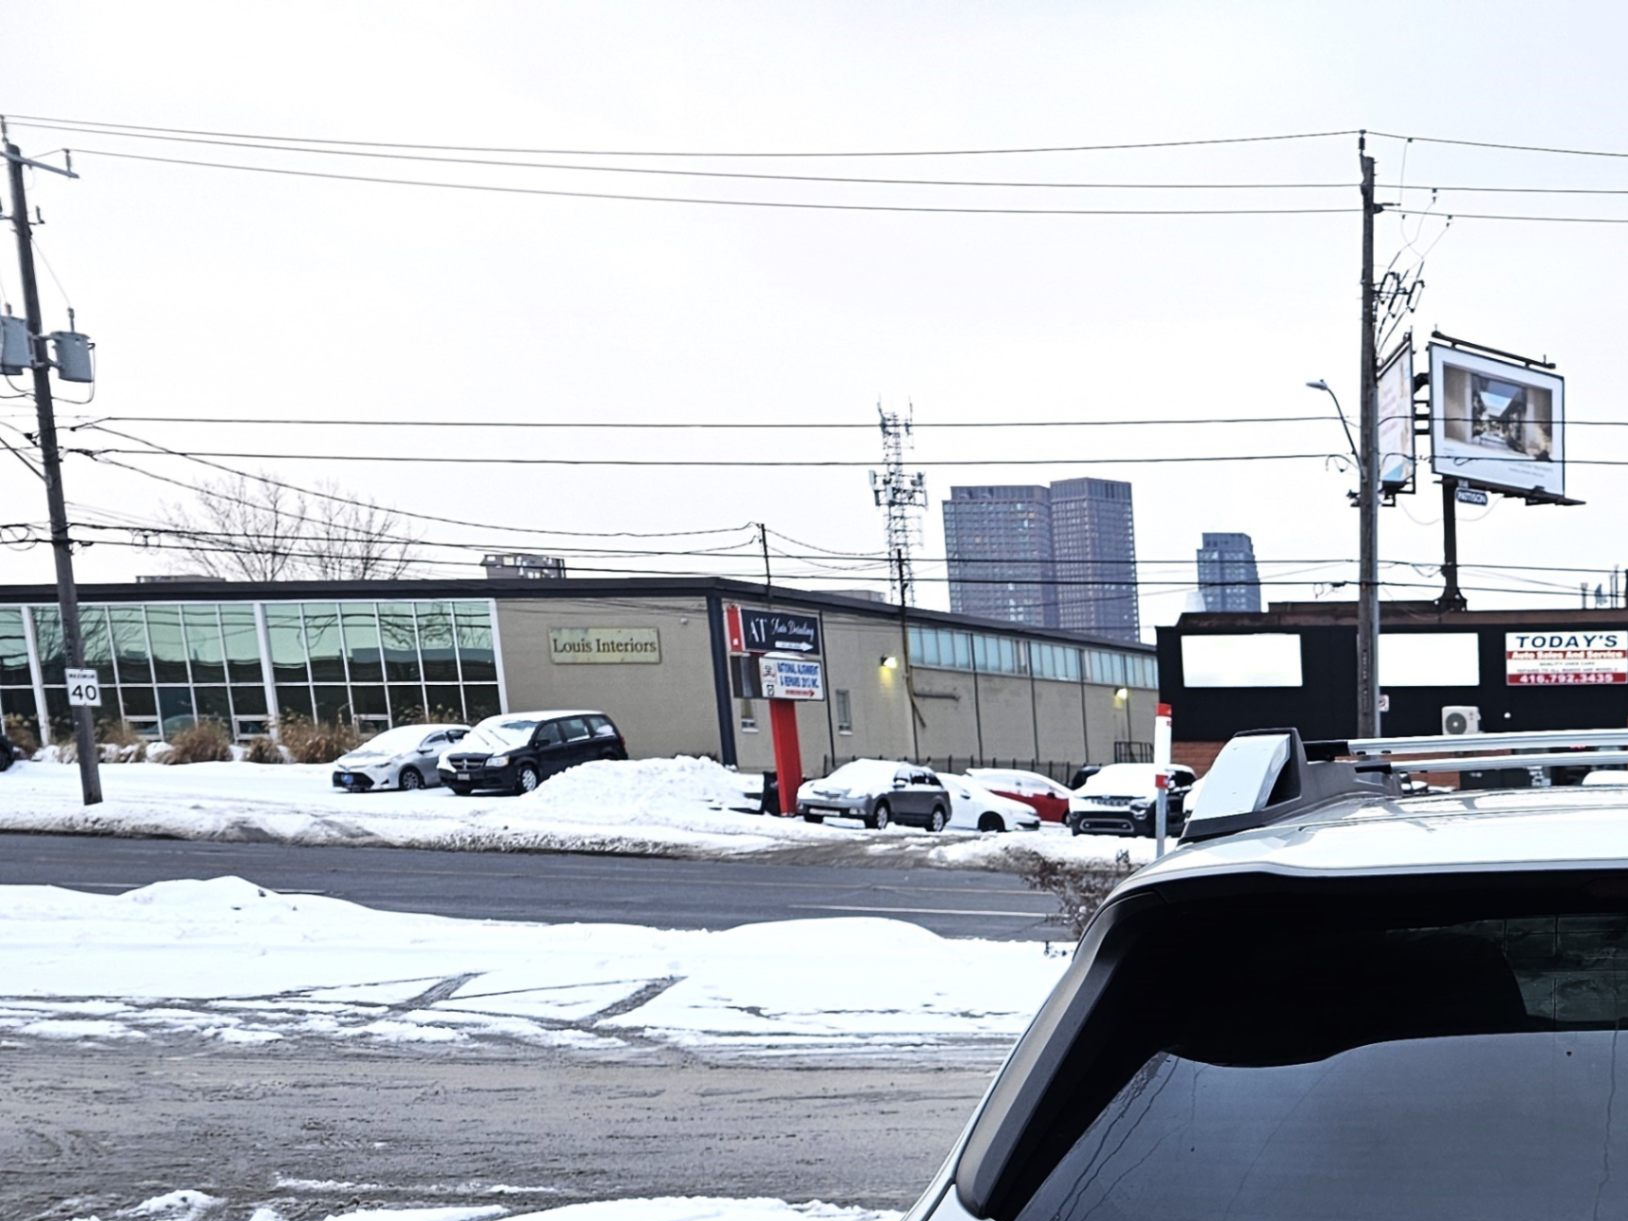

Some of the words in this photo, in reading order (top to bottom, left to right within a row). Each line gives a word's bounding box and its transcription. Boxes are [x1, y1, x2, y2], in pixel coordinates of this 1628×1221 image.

[553, 638, 593, 654] Louis
[596, 638, 657, 654] Interiors
[1515, 634, 1619, 649] TODAY'S
[1510, 650, 1536, 660] Auto
[1565, 650, 1585, 660] And
[1586, 649, 1624, 660] Service
[71, 684, 97, 701] 40
